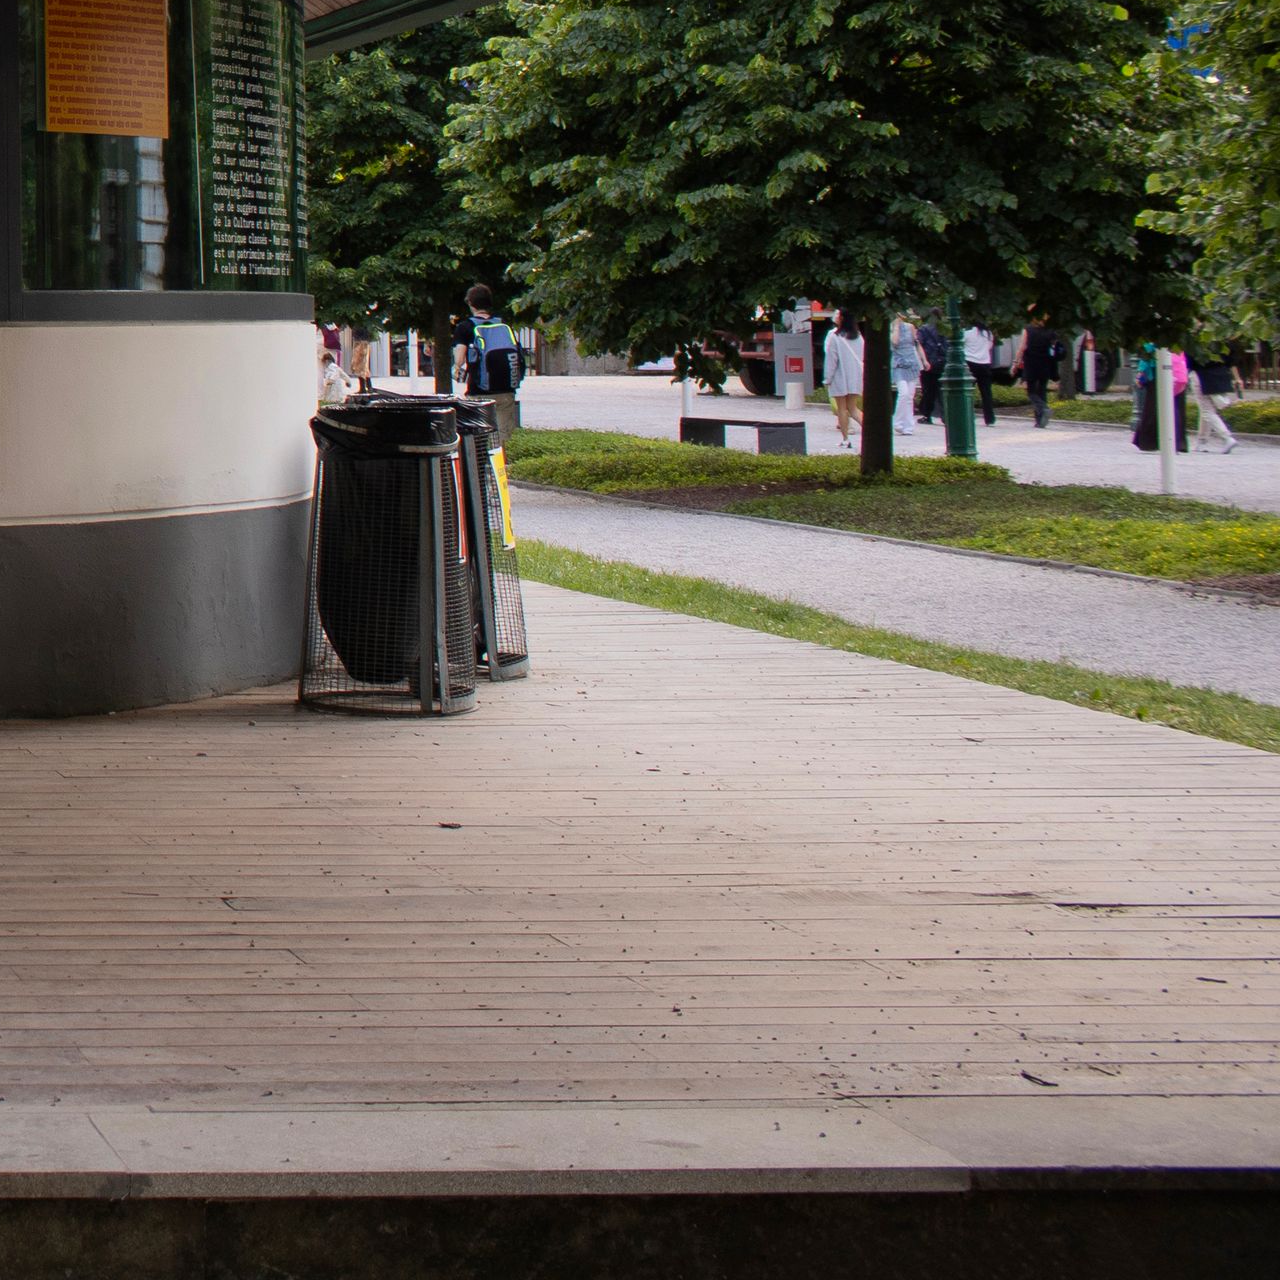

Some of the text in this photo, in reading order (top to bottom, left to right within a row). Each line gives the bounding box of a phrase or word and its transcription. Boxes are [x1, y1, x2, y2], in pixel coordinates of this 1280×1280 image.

[212, 77, 235, 90] projets
[212, 91, 229, 103] leurs
[213, 171, 228, 180] nous
[213, 202, 224, 213] que
[227, 201, 234, 212] de
[213, 215, 221, 227] de
[224, 216, 231, 227] la
[233, 217, 255, 229] Culture
[213, 231, 247, 245] historique
[213, 248, 225, 258] est
[227, 249, 235, 258] un
[221, 262, 238, 274] celui
[240, 263, 247, 274] de
